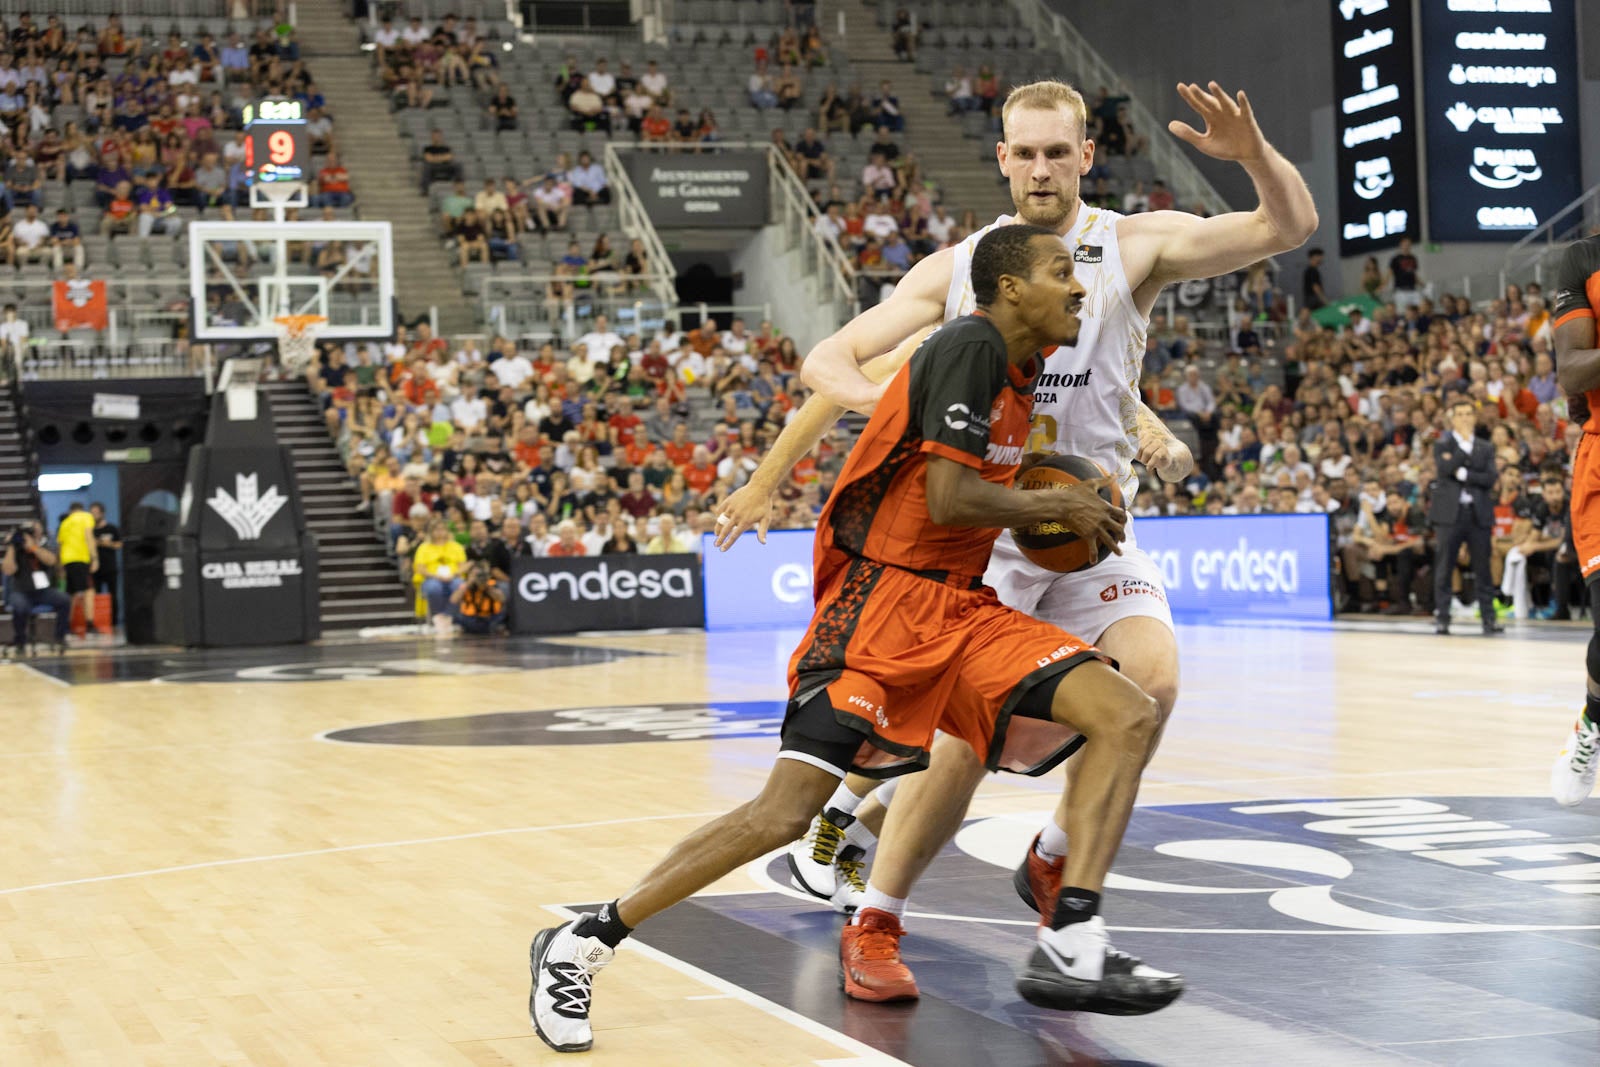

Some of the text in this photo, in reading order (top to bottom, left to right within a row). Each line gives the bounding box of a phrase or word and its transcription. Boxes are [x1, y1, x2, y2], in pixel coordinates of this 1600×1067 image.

[268, 130, 295, 165] 9
[518, 562, 694, 602] endesa
[1191, 535, 1299, 594] endesa
